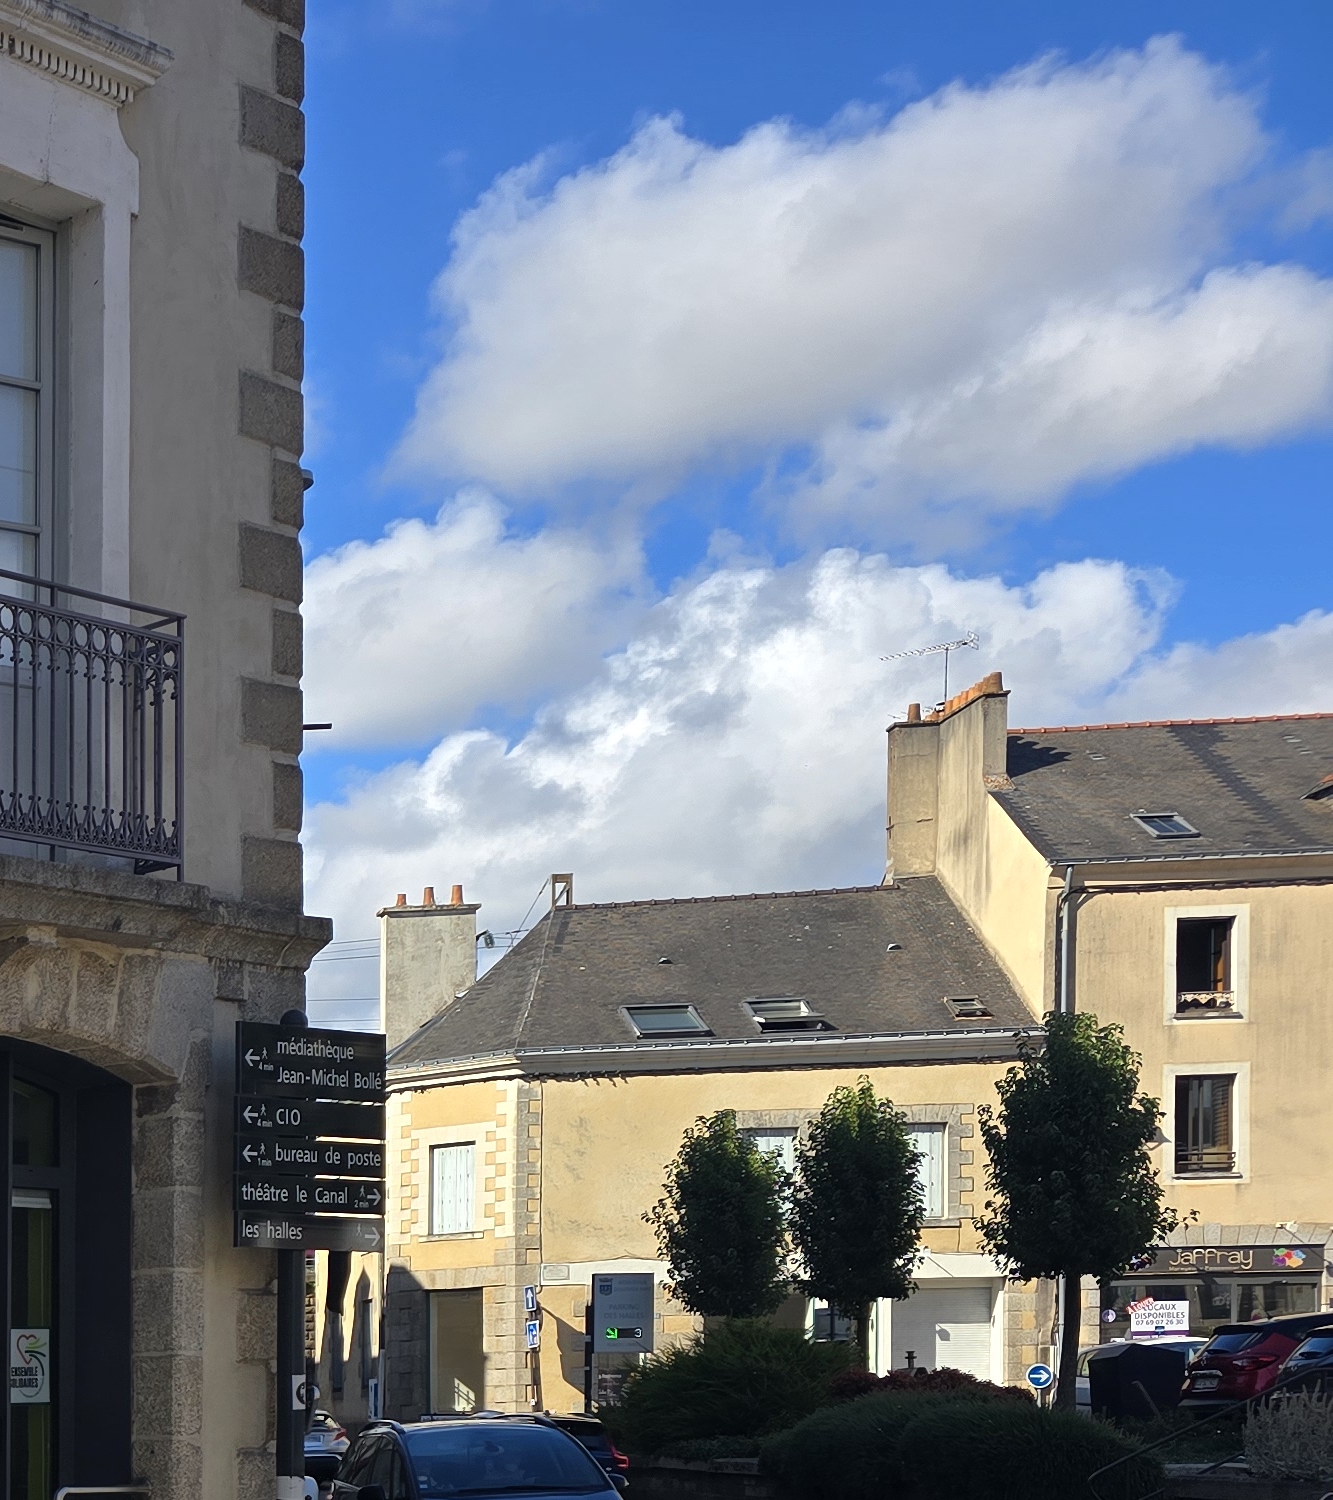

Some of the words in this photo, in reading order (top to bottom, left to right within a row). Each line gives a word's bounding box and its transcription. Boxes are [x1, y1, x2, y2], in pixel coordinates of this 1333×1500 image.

[277, 1037, 354, 1063] médiathèque
[258, 1062, 263, 1071] 4
[263, 1062, 274, 1071] min
[277, 1066, 349, 1088] Jean-Michel
[354, 1072, 382, 1090] Bollé
[257, 1119, 261, 1127] 4
[262, 1120, 272, 1128] min
[276, 1108, 301, 1126] CIO
[261, 1158, 272, 1166] min
[275, 1143, 318, 1163] bureau
[325, 1146, 341, 1164] de
[348, 1151, 382, 1169] poste
[242, 1182, 289, 1202] théâtre
[296, 1184, 308, 1203] le
[315, 1187, 348, 1204] Canal
[354, 1200, 359, 1208] 2
[359, 1200, 369, 1208] min
[242, 1220, 259, 1238] les
[267, 1220, 303, 1240] halles
[1169, 1248, 1253, 1269] jaffray
[1134, 1311, 1185, 1319] DISPONIBLES
[634, 1328, 642, 1338] 3
